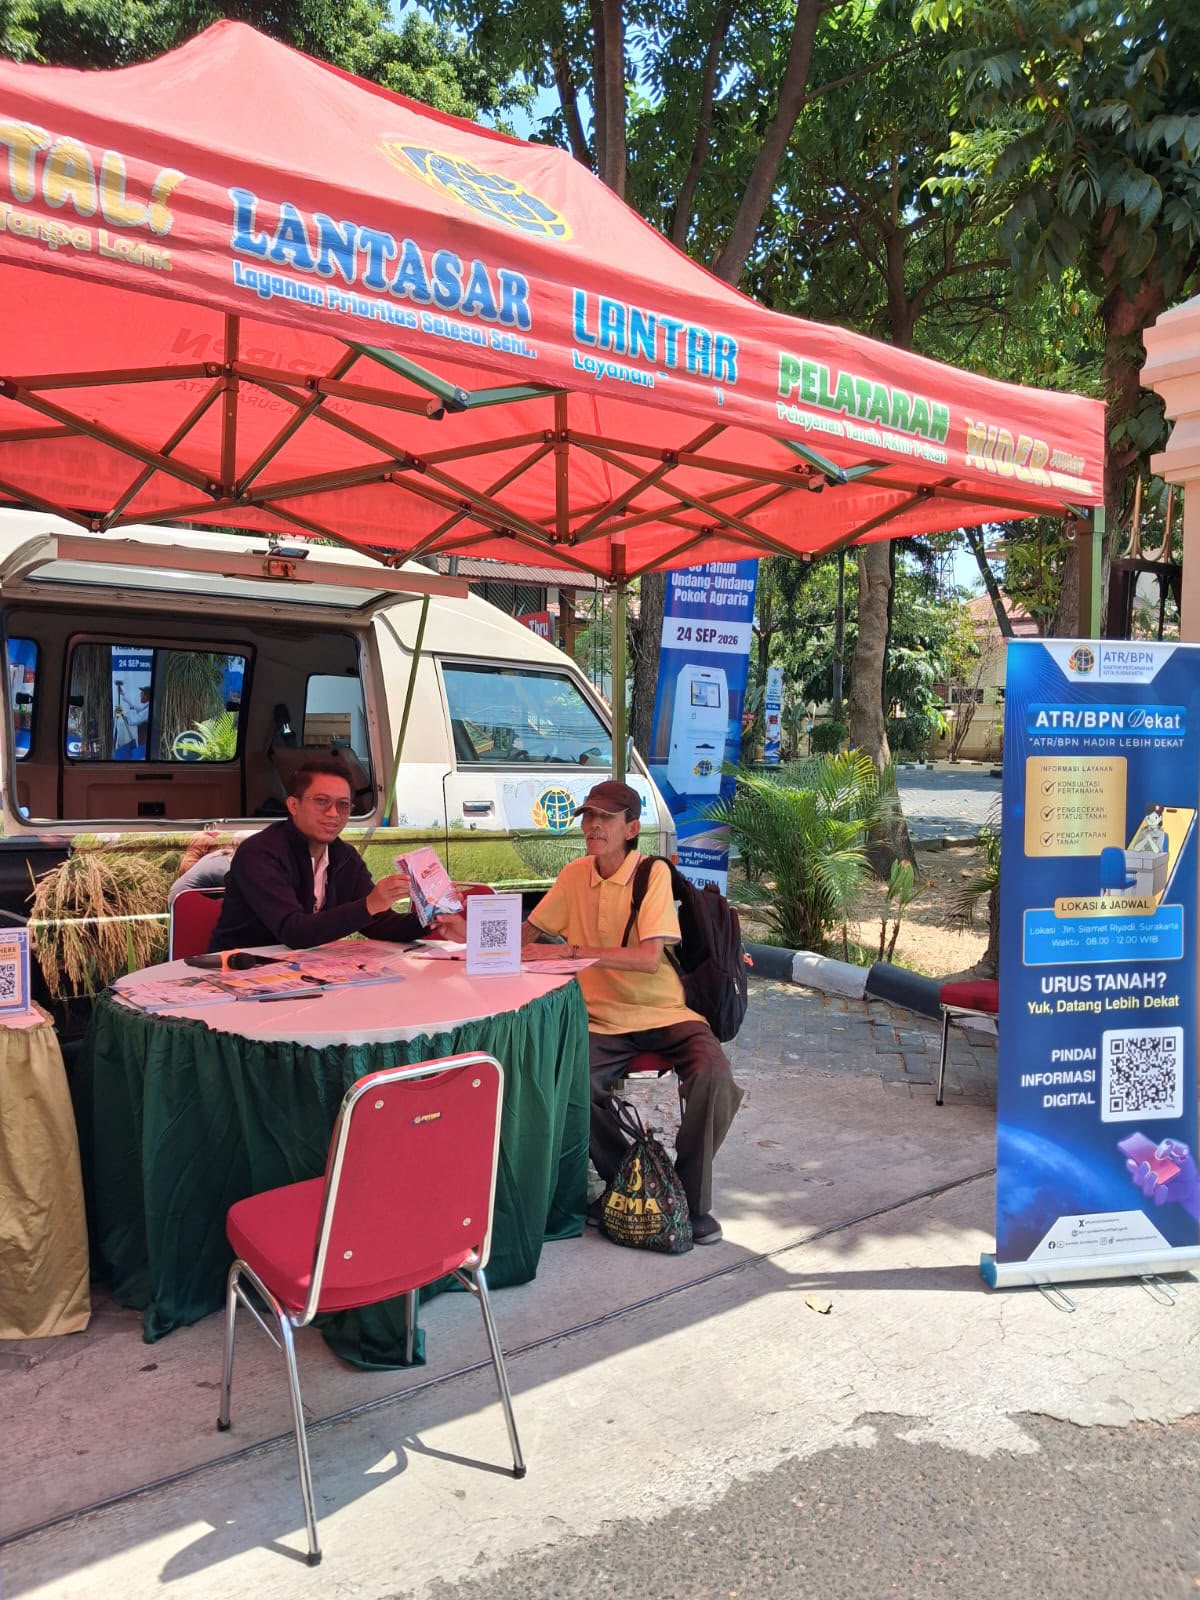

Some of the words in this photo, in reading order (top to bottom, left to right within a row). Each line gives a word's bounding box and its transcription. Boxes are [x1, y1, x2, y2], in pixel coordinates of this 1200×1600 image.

[228, 187, 531, 331] LANTASAR
[232, 260, 323, 299] Layanan
[327, 285, 418, 329] Prioritas
[421, 311, 488, 347] Selesai
[572, 287, 739, 385] LANTAR
[571, 348, 654, 388] Layanan
[777, 352, 950, 444] PELATARAN
[776, 401, 844, 436] Pelayanan
[842, 419, 881, 447] Tanah
[671, 573, 755, 592] Undang-Undang
[674, 589, 707, 603] Pokok
[710, 591, 749, 606] Agraria
[528, 620, 549, 637] Thru
[677, 627, 692, 641] 24
[696, 628, 717, 643] SEP
[718, 634, 738, 645] 2026
[1104, 651, 1153, 663] ATR/BPN
[1035, 710, 1124, 729] ATR/BPN
[1127, 708, 1181, 729] Dekat
[1084, 738, 1116, 747] HADIR
[1119, 738, 1150, 747] LEBIH
[1154, 739, 1184, 748] DEKAT
[1057, 787, 1104, 795] PERTANAHAN
[1061, 901, 1098, 911] LOKASI
[1100, 901, 1107, 910] &
[1109, 900, 1149, 910] JADWAL
[1078, 924, 1108, 933] Slamet
[1139, 922, 1179, 932] Surakarta
[1116, 936, 1137, 945] 12.00
[1139, 936, 1159, 944] WIB
[1041, 974, 1092, 994] URUS
[1095, 972, 1167, 991] TANAH?
[1027, 1001, 1053, 1014] Yuk,
[1056, 999, 1101, 1014] Datang
[1105, 997, 1139, 1010] Lebih
[1143, 995, 1179, 1007] Dekat
[1051, 1048, 1096, 1062] PINDAI
[1021, 1070, 1096, 1087] INFORMASI
[1043, 1092, 1096, 1108] DIGITAL
[607, 1191, 662, 1215] BMA
